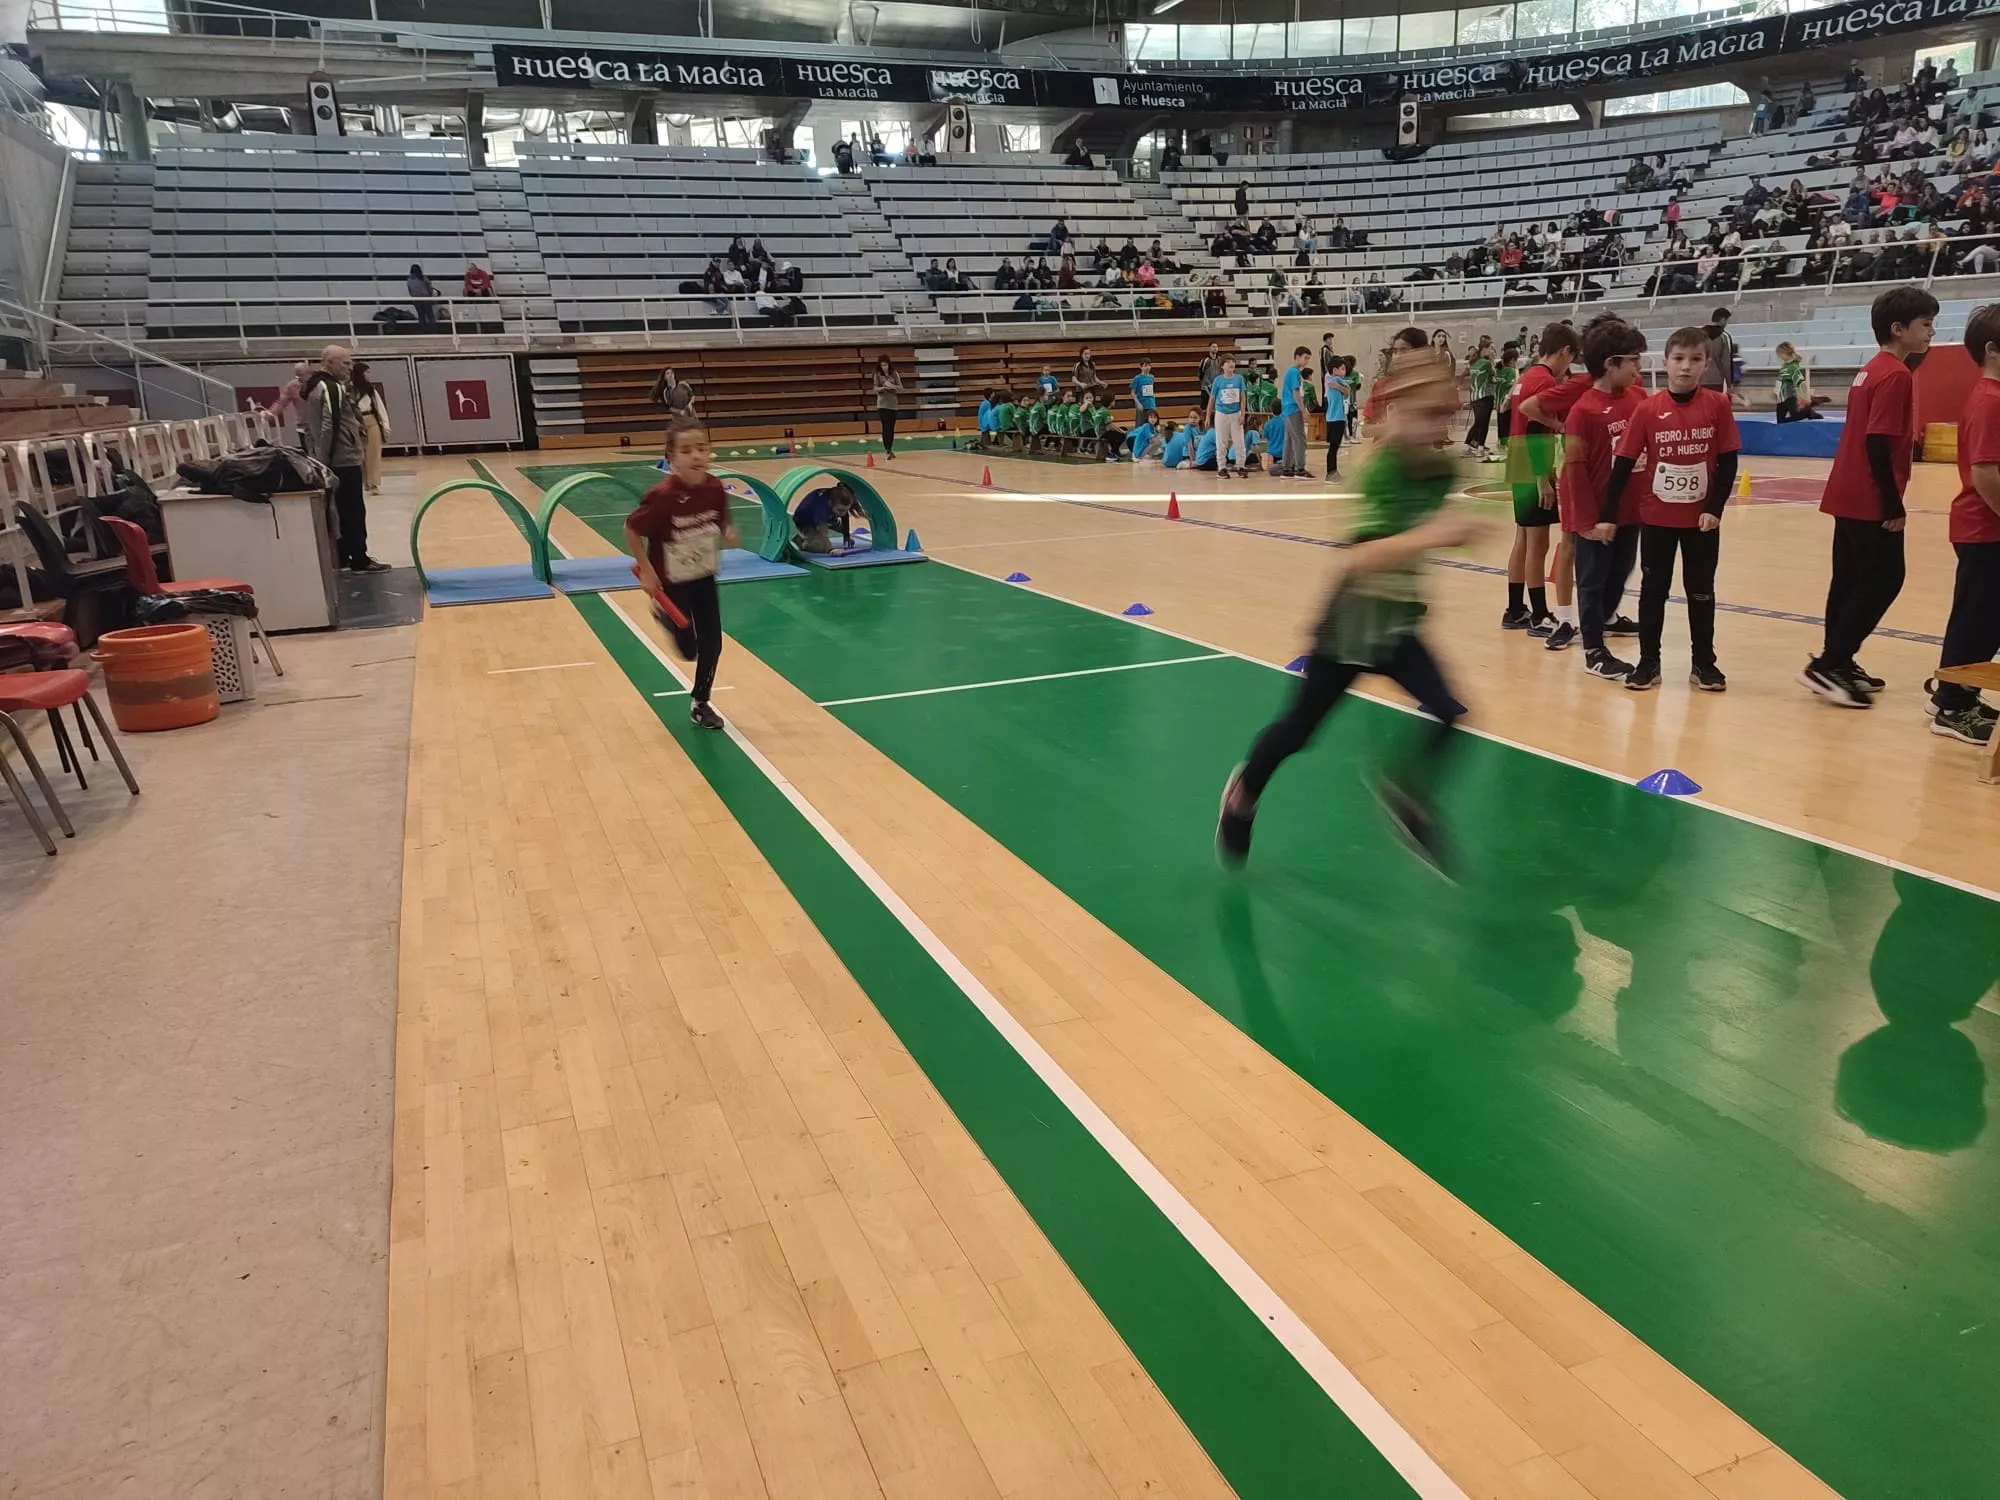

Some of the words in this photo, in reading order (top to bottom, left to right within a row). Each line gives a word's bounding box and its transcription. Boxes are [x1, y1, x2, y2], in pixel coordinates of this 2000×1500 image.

[1122, 79, 1204, 94] Ayuntamiento
[1124, 94, 1138, 106] de
[1141, 94, 1186, 108] Huesca
[1799, 302, 1809, 316] 5
[1459, 331, 1467, 343] 2
[1655, 429, 1682, 443] PEDRO
[1682, 429, 1690, 441] J.
[1691, 426, 1714, 440] RUBIO
[1659, 446, 1674, 457] C.P.
[1677, 443, 1709, 456] HUESCA
[1663, 475, 1699, 491] 598
